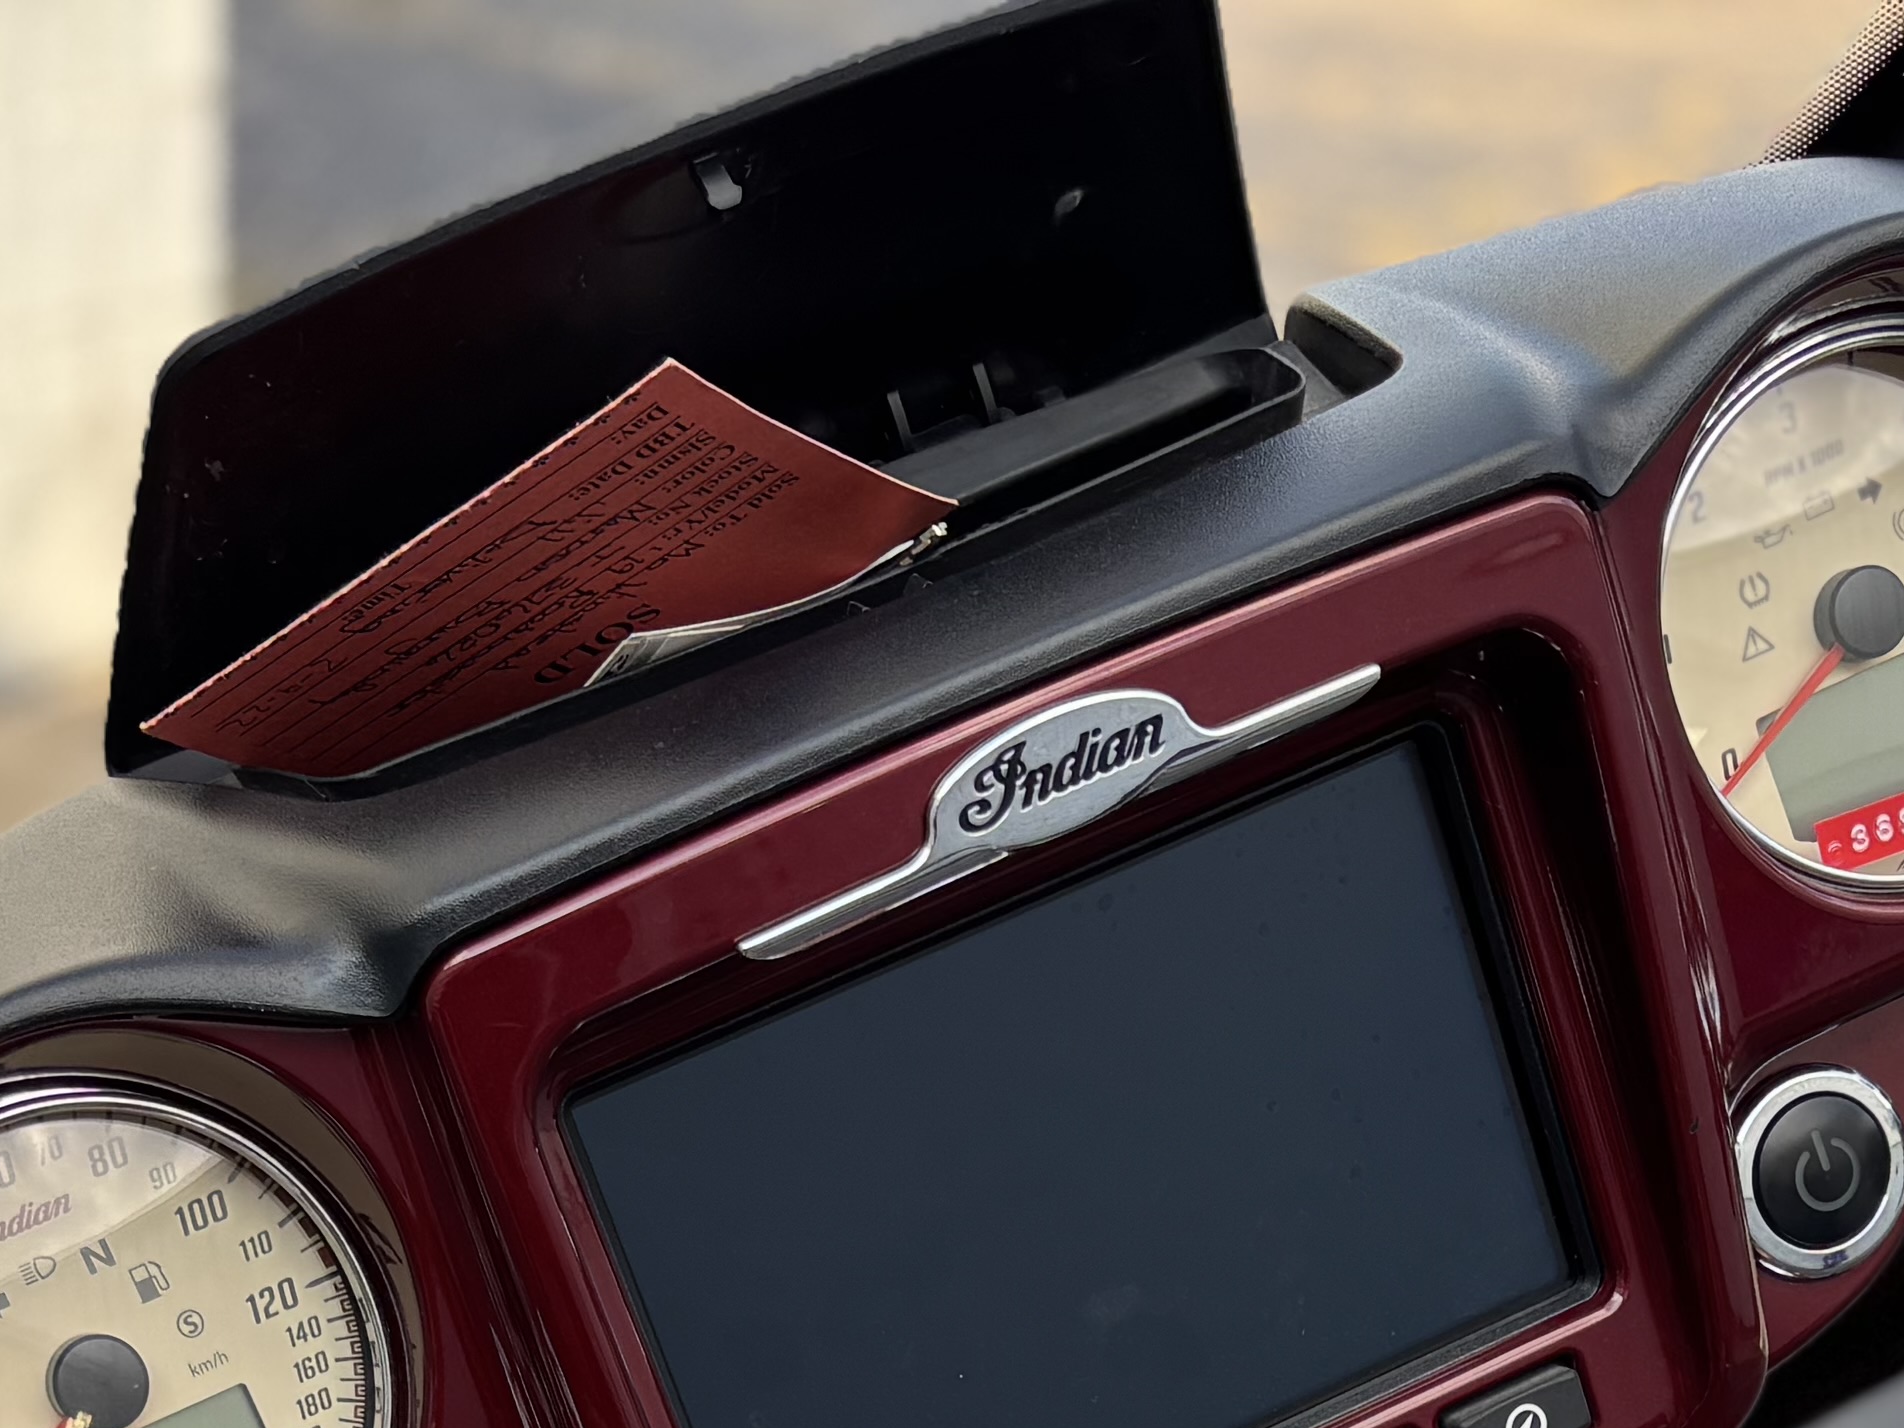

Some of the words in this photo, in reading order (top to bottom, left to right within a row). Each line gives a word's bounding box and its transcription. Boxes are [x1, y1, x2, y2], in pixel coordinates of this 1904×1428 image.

[608, 404, 669, 444] Day:
[626, 416, 694, 458] TBD
[629, 432, 716, 484] Slsmn:
[656, 443, 735, 492] Color:
[688, 452, 758, 496] Stock
[568, 460, 632, 500] Date:
[742, 472, 799, 508] Sold
[643, 497, 691, 525] No:
[657, 463, 779, 540] Model/Yr:
[699, 507, 747, 536] To:
[1687, 490, 1705, 523] 2
[534, 603, 660, 683] SOLD
[957, 712, 1165, 835] Indian
[87, 1135, 129, 1177] 80
[148, 1161, 177, 1191] 90
[174, 1189, 229, 1237] 100
[79, 1237, 118, 1276] N
[238, 1230, 274, 1263] 110
[245, 1277, 300, 1325] 120
[285, 1315, 322, 1348] 140
[188, 1350, 230, 1379] km/h
[293, 1350, 330, 1384] 160
[296, 1386, 333, 1421] 180
